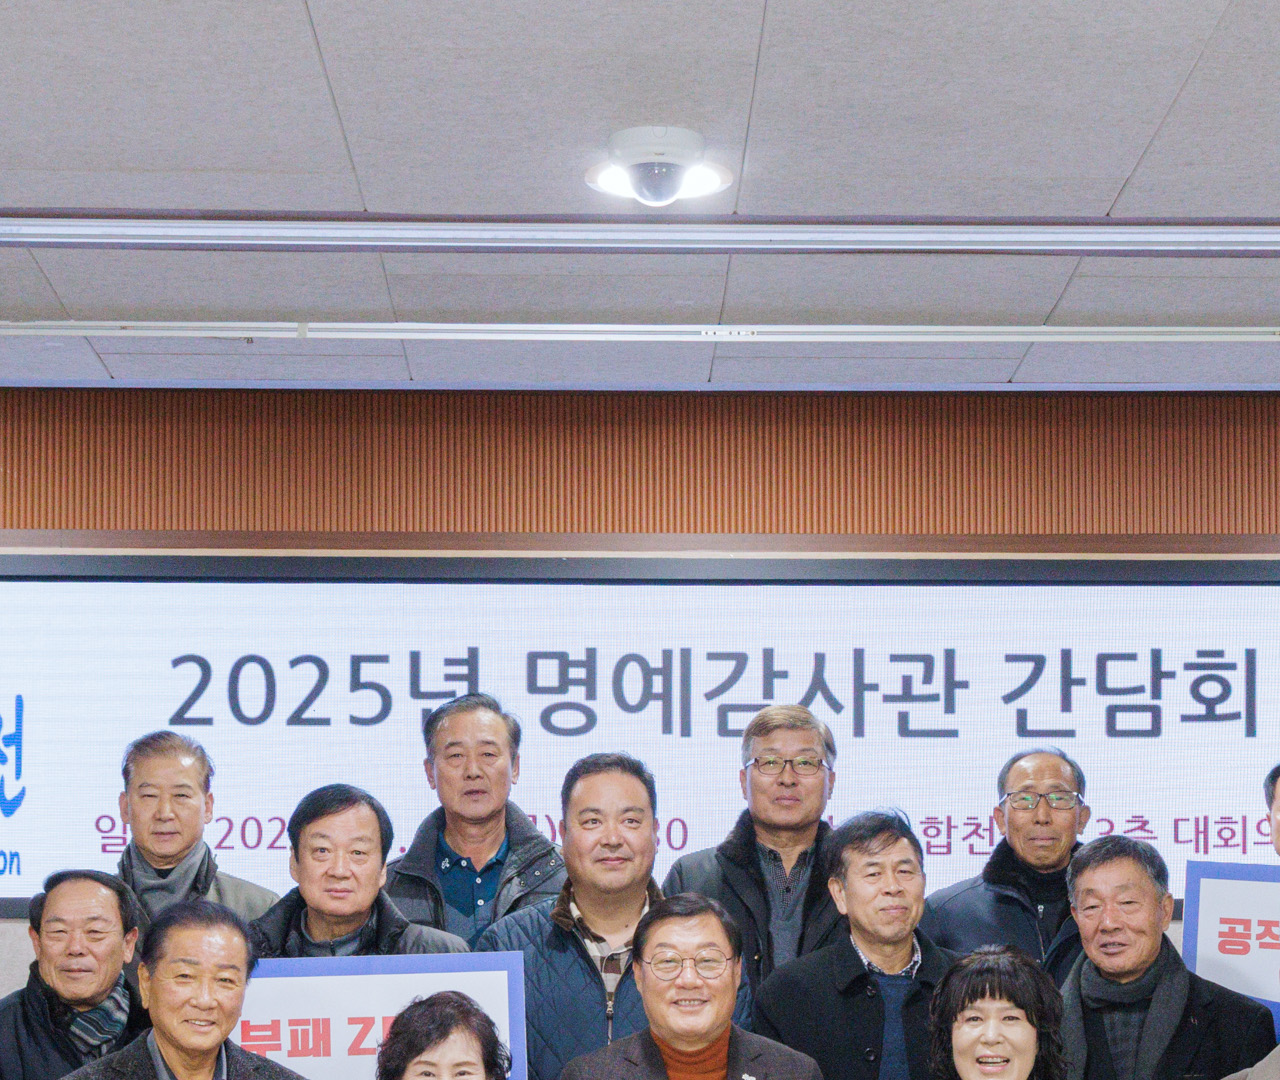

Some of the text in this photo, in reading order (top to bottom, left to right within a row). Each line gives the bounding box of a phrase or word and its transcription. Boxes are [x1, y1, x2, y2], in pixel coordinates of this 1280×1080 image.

[170, 646, 1257, 738] 2025년 명예감사관 간담회
[214, 815, 288, 850] 202
[240, 1017, 331, 1058] 부패
